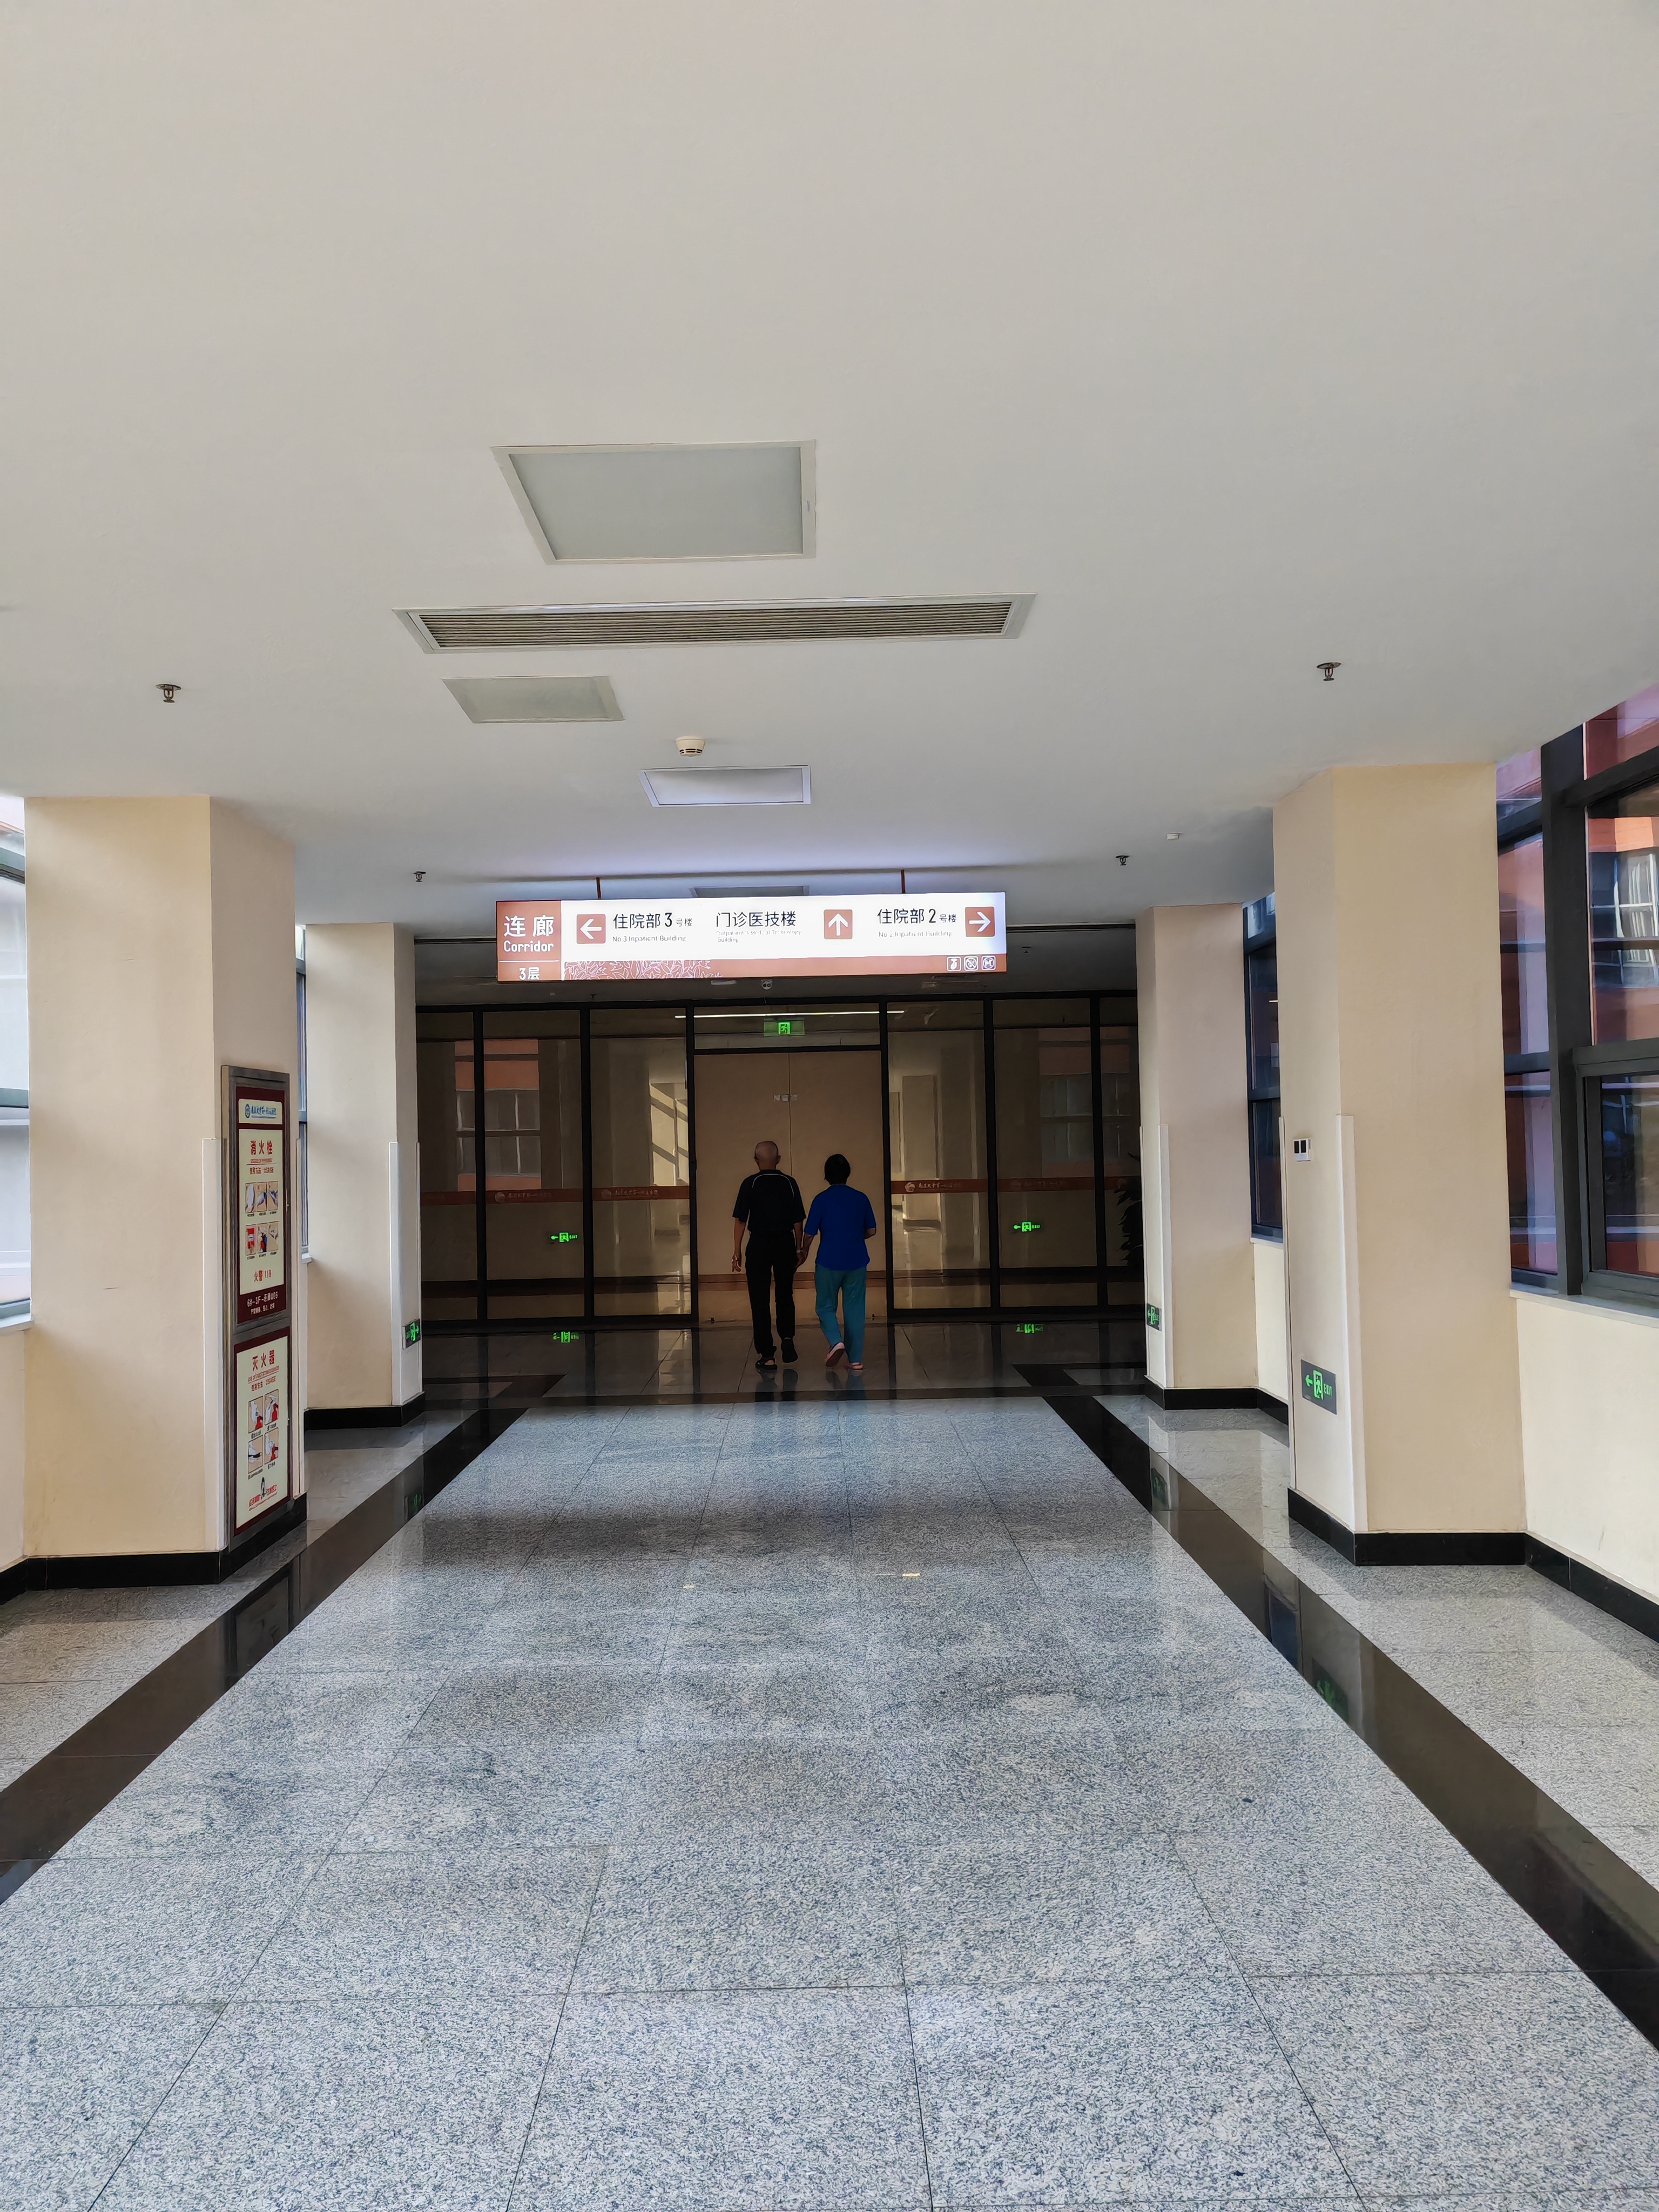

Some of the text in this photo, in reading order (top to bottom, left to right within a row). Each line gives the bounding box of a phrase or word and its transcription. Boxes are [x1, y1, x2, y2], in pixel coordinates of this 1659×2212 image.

[504, 915, 554, 937] 连廊
[716, 911, 796, 927] 门诊医技楼
[926, 930, 953, 938] Building
[503, 940, 554, 952] Corridor
[519, 967, 540, 981] 3层
[252, 1349, 275, 1372] 灭火器
